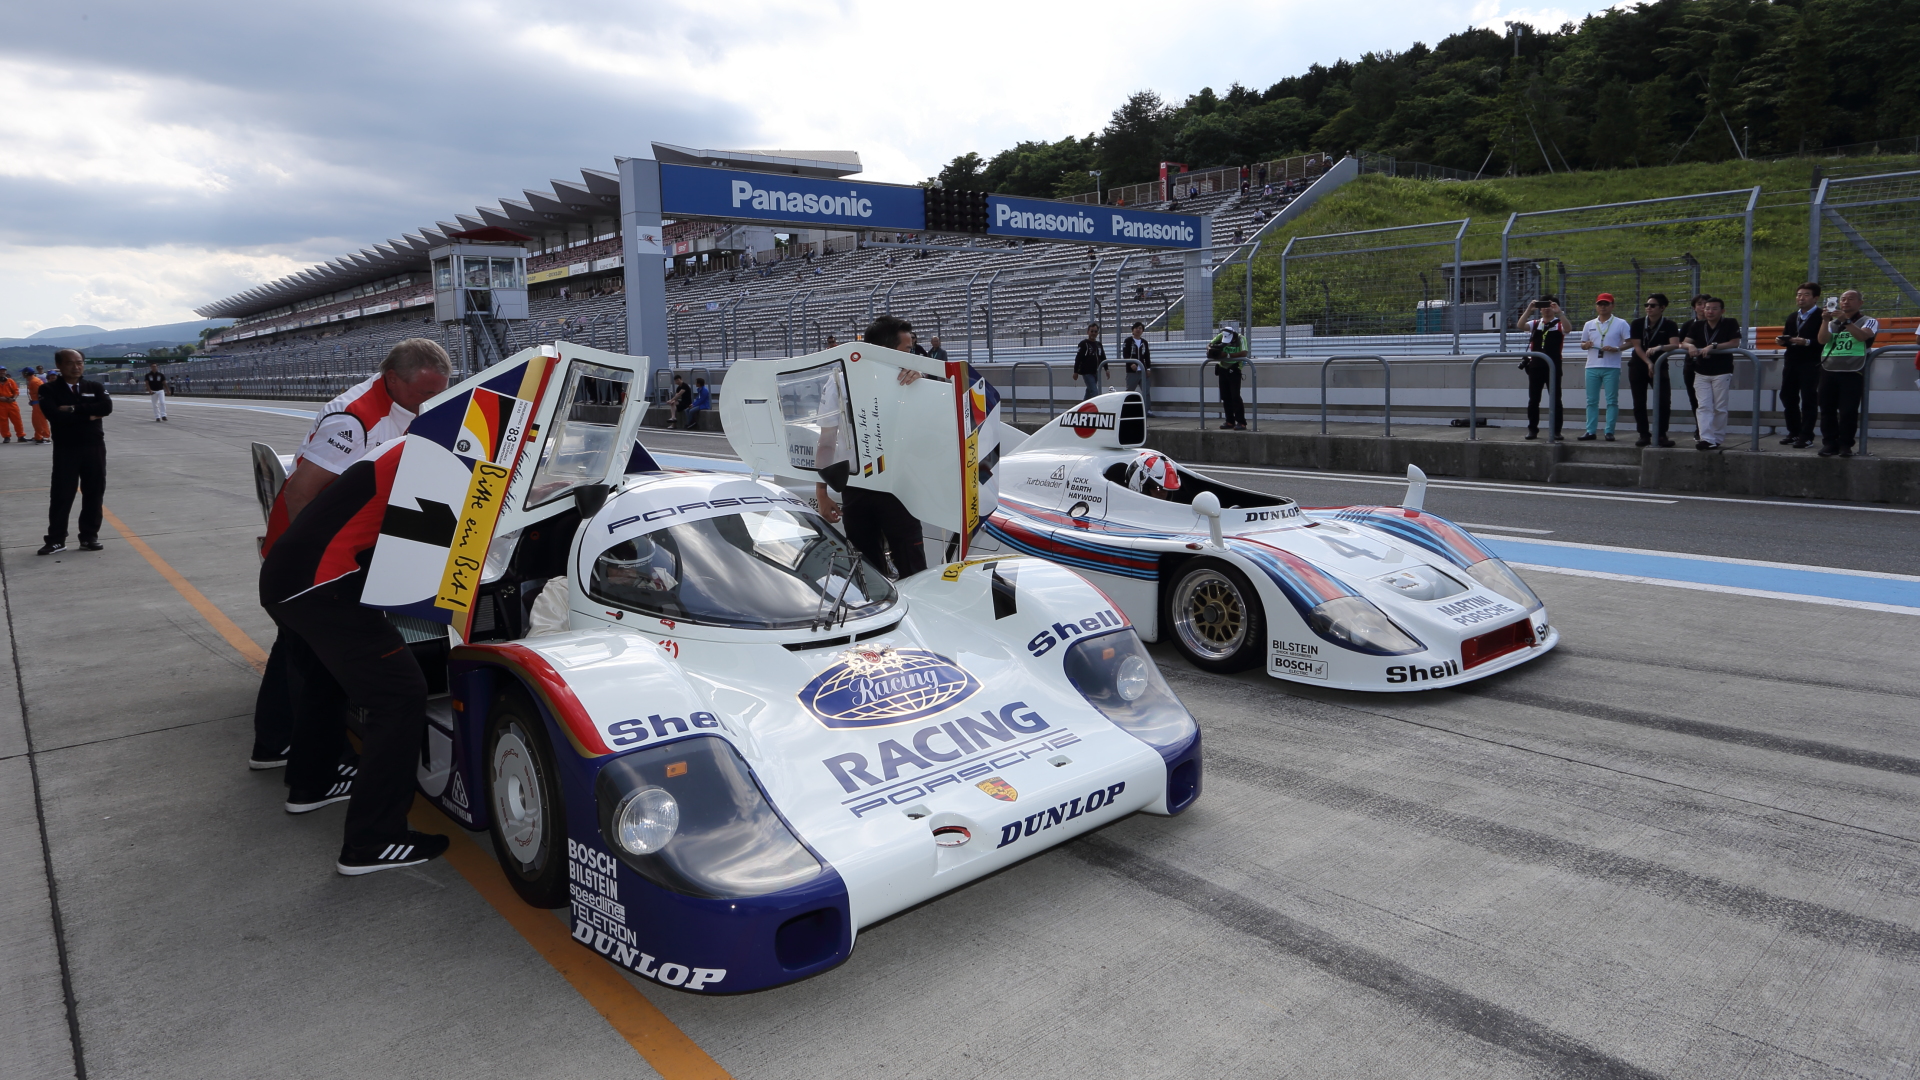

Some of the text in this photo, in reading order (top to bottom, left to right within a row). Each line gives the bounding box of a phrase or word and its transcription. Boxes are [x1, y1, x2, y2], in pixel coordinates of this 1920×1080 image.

[731, 179, 873, 218] Panasonic
[996, 204, 1095, 234] Panasonic
[1112, 215, 1194, 242] Panasonic
[1488, 313, 1496, 329] 1
[1060, 413, 1115, 429] MARTINI
[327, 437, 345, 451] Mobil
[339, 431, 353, 443] adidas
[789, 444, 814, 456] ARTINI
[790, 457, 816, 468] RSCHE
[1026, 477, 1063, 489] Turbolader
[1070, 484, 1092, 493] BARTH
[1072, 477, 1089, 485] ICKX
[1068, 492, 1102, 504] HAYWOOD
[607, 496, 811, 534] PORSCHE
[1245, 506, 1300, 523] DUNLOP
[440, 464, 508, 608] Bitte ein Bit!
[1437, 595, 1495, 617] MARTINI
[1453, 603, 1515, 626] PORSCHE
[1027, 609, 1121, 658] Shell
[1272, 639, 1319, 655] BILSTEIN
[1275, 657, 1313, 672] BOSCH
[1385, 659, 1459, 684] Shell
[848, 669, 939, 707] Racing
[822, 701, 1050, 794] RACING
[849, 733, 1082, 819] PORSCHE
[997, 781, 1126, 849] DUNLOP
[567, 837, 617, 879] BOSCH
[568, 859, 618, 901] BILSTEIN
[569, 882, 621, 918] speedline
[570, 899, 637, 948] TELETRON
[572, 919, 727, 991] DUNLOP
